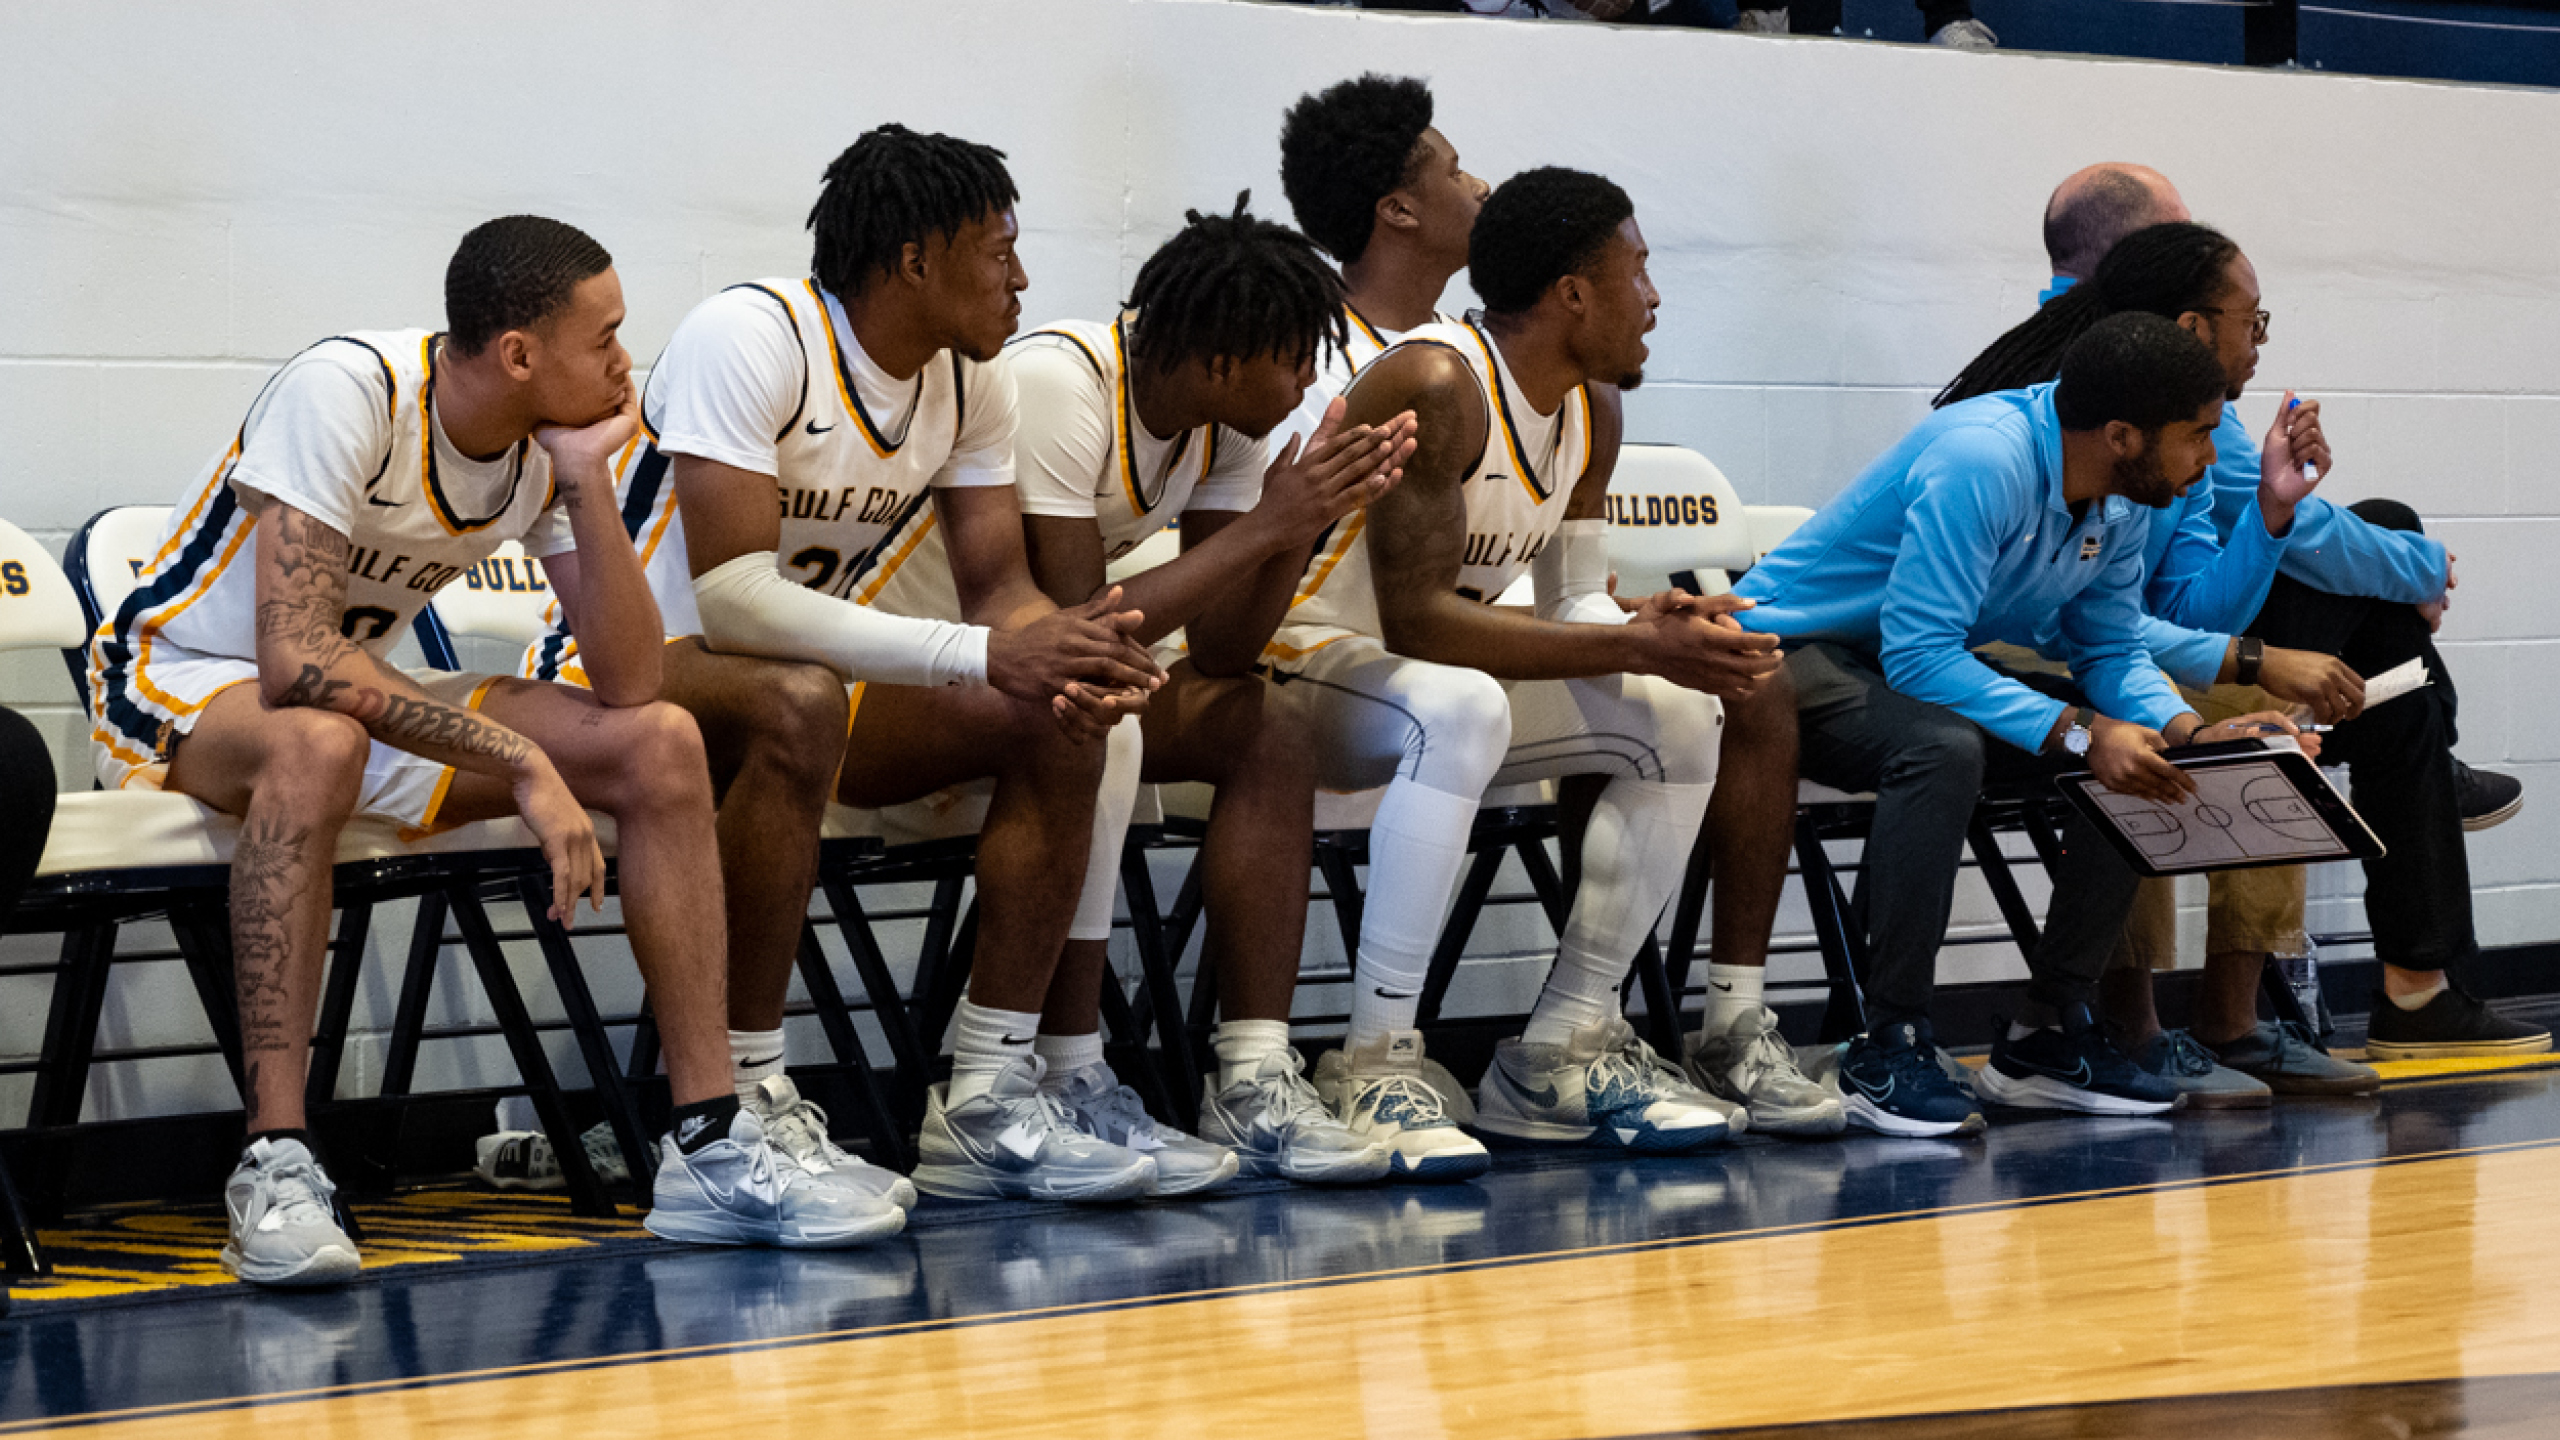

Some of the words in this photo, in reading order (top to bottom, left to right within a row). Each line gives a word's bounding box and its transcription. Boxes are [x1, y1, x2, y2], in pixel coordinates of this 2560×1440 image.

[347, 544, 411, 583] ULF
[1462, 531, 1514, 567] ULF
[465, 555, 549, 593] BULL
